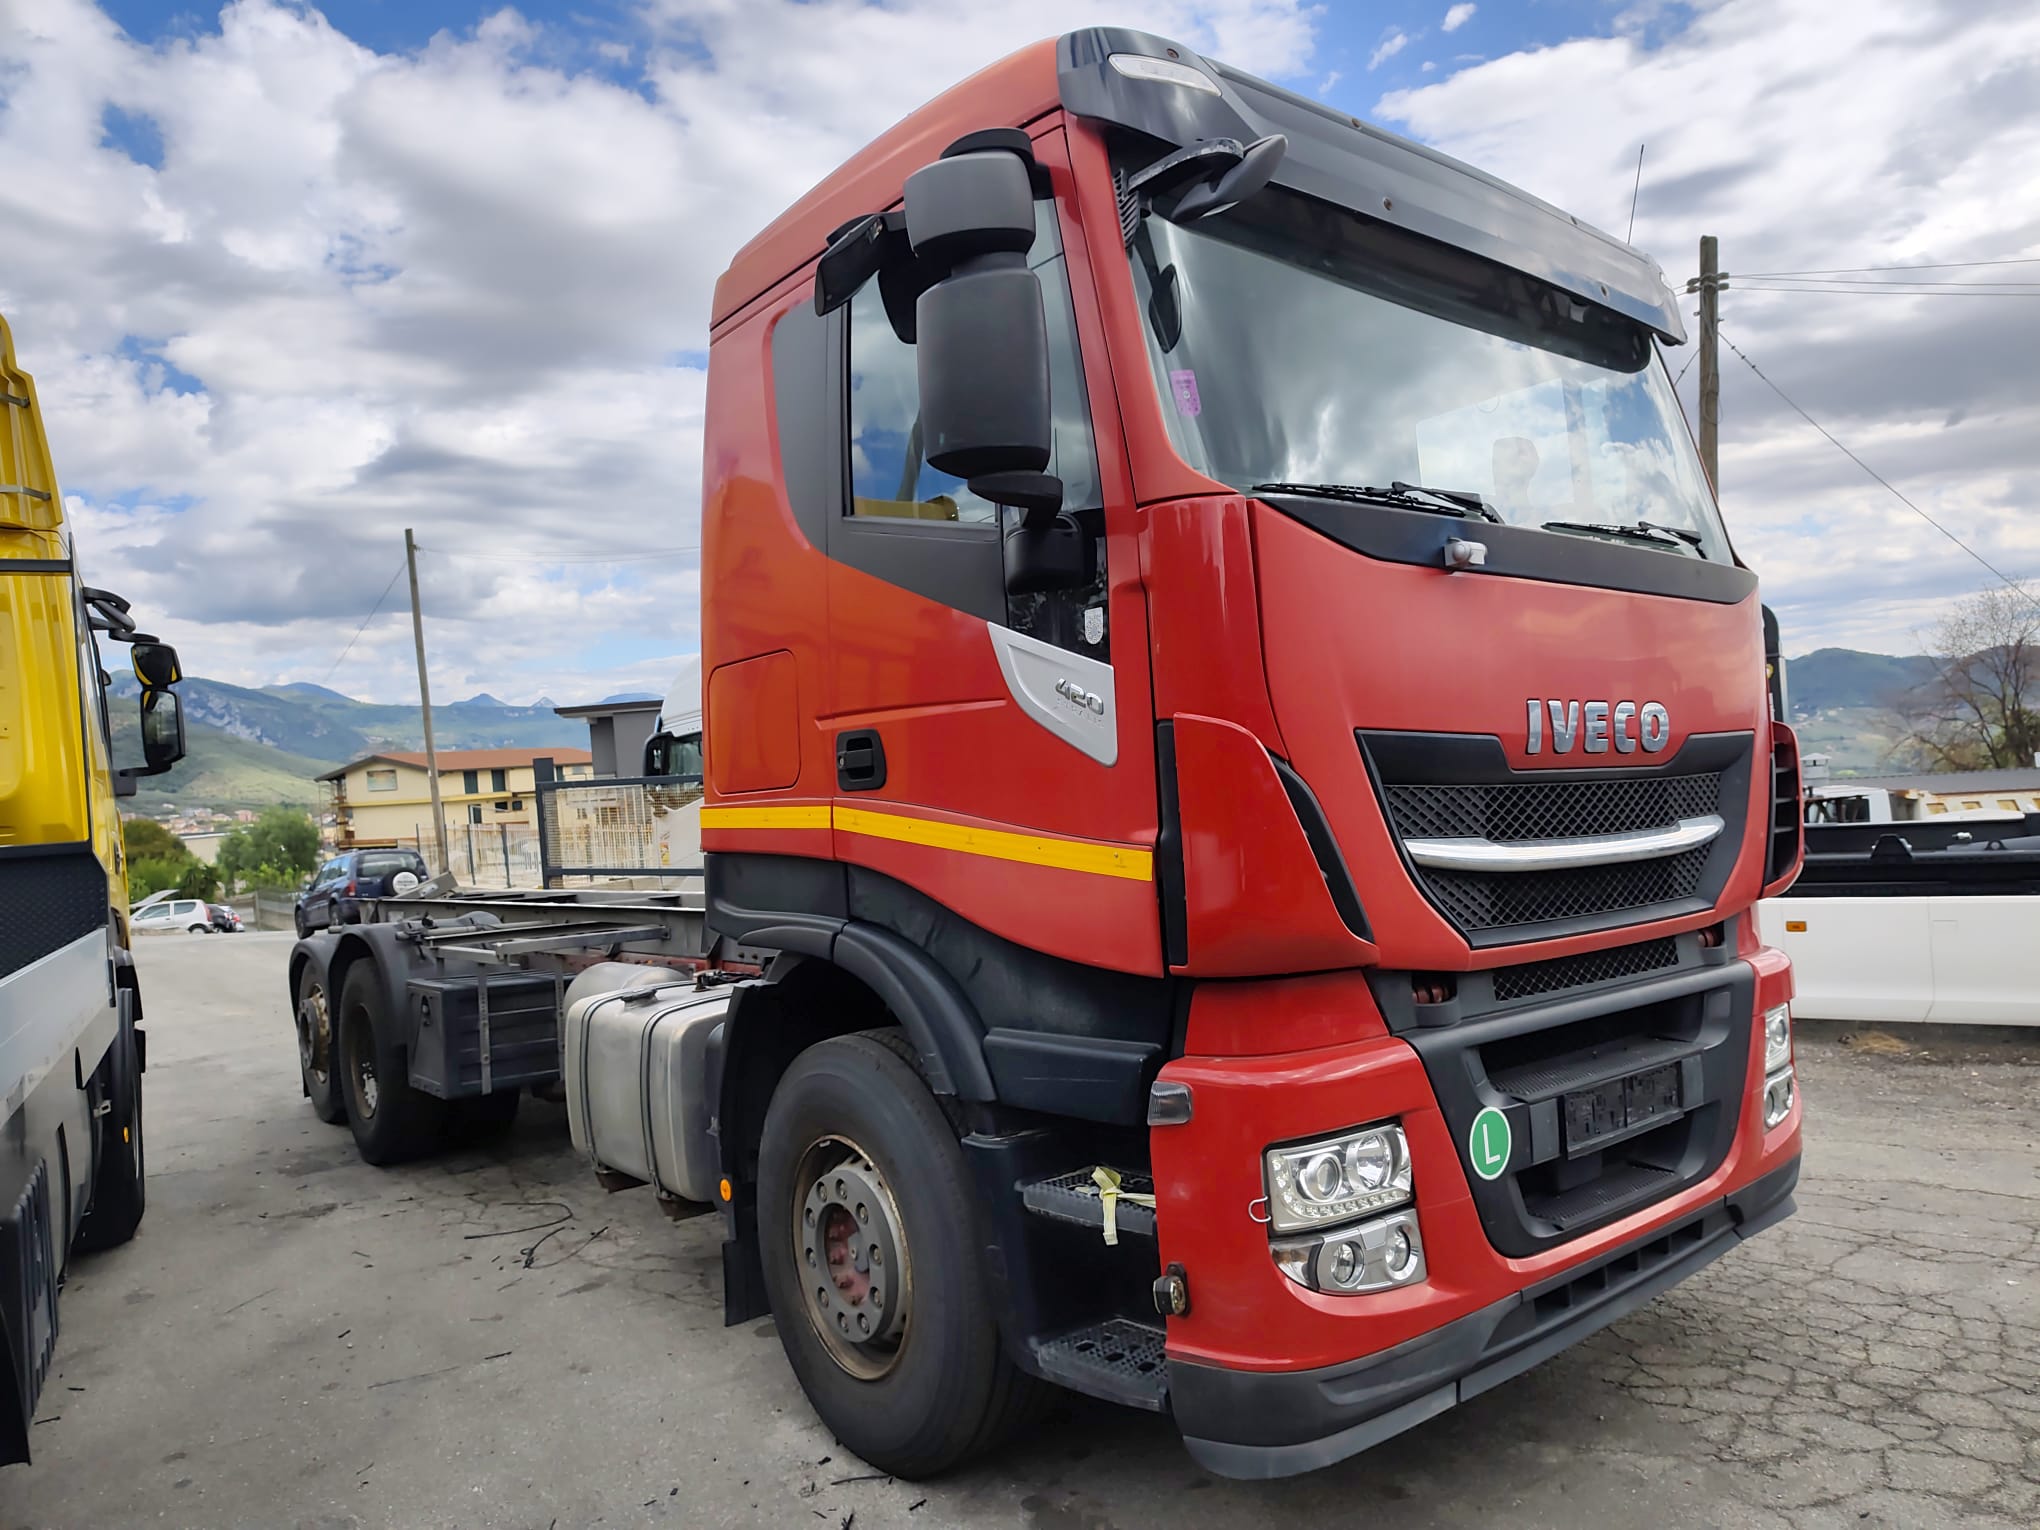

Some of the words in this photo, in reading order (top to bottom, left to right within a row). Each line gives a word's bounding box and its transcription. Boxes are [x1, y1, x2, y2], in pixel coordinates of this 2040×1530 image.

[1055, 678, 1104, 715] 420
[1526, 699, 1670, 754] IVECO
[1482, 1123, 1501, 1165] L
